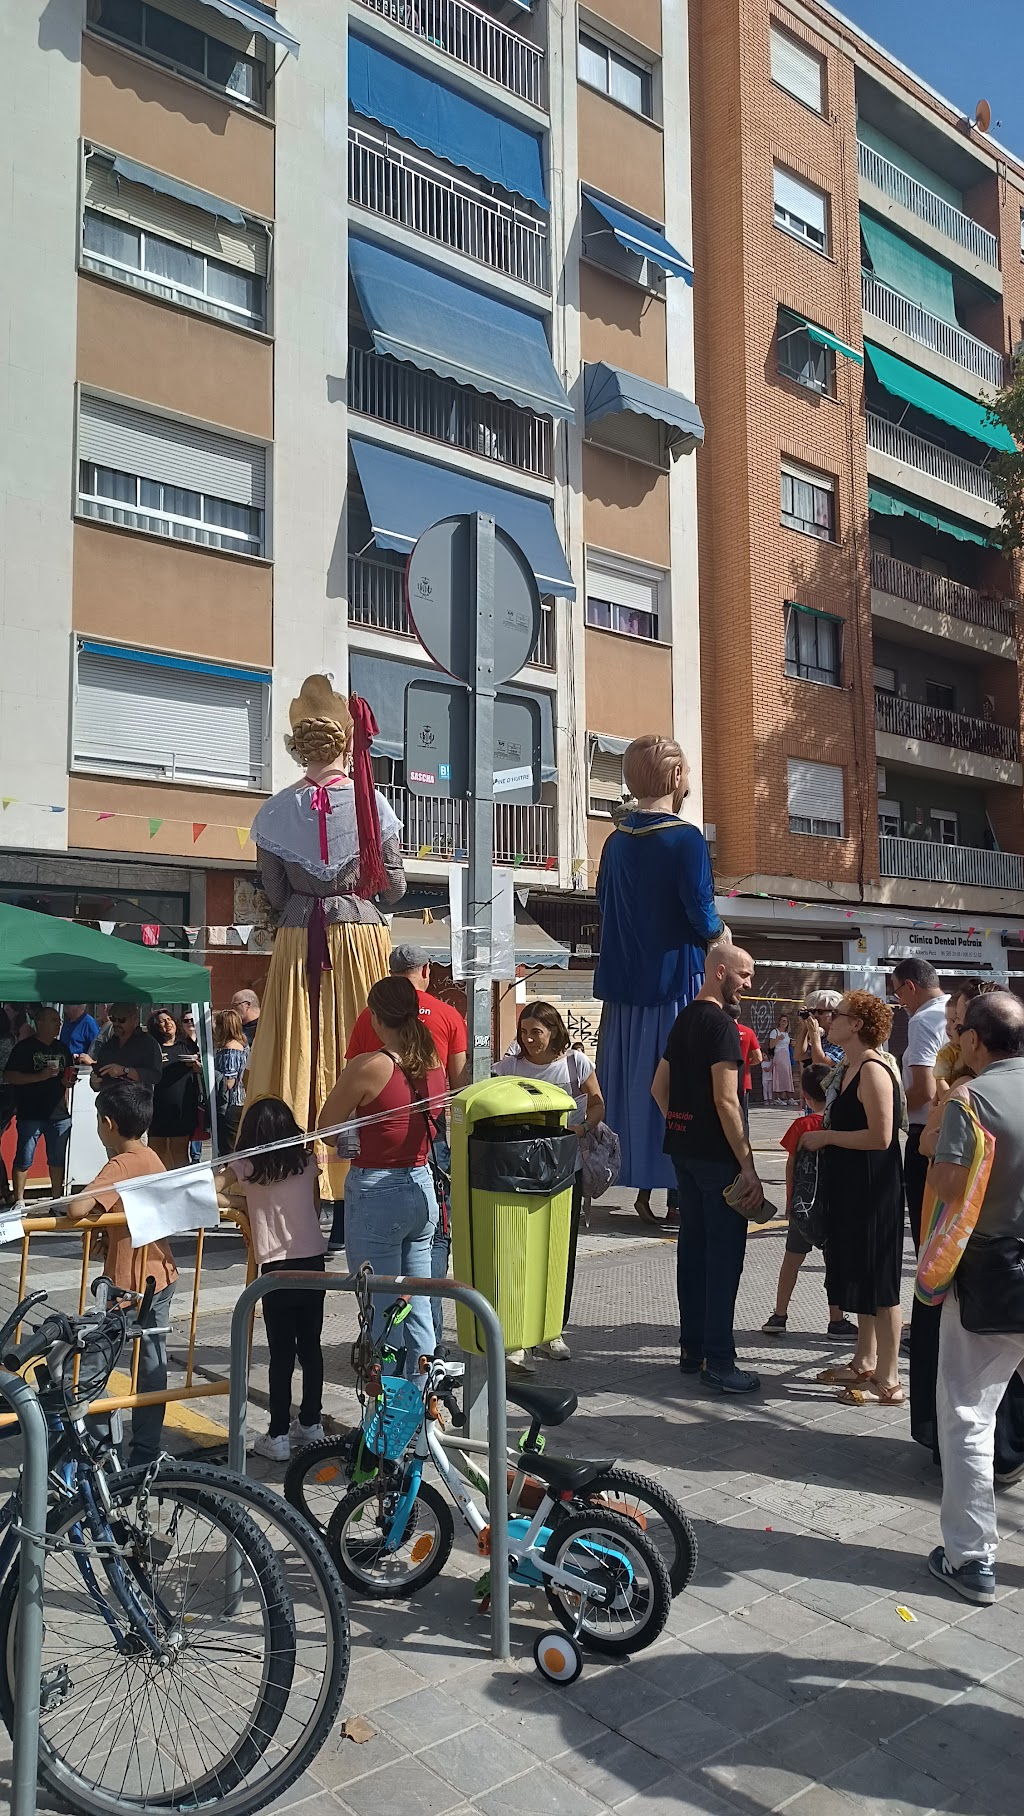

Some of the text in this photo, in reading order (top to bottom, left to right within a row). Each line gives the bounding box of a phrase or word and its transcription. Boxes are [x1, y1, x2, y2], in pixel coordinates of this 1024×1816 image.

[410, 771, 435, 784] SASCHA
[909, 934, 982, 947] Clínica Dental Patraix
